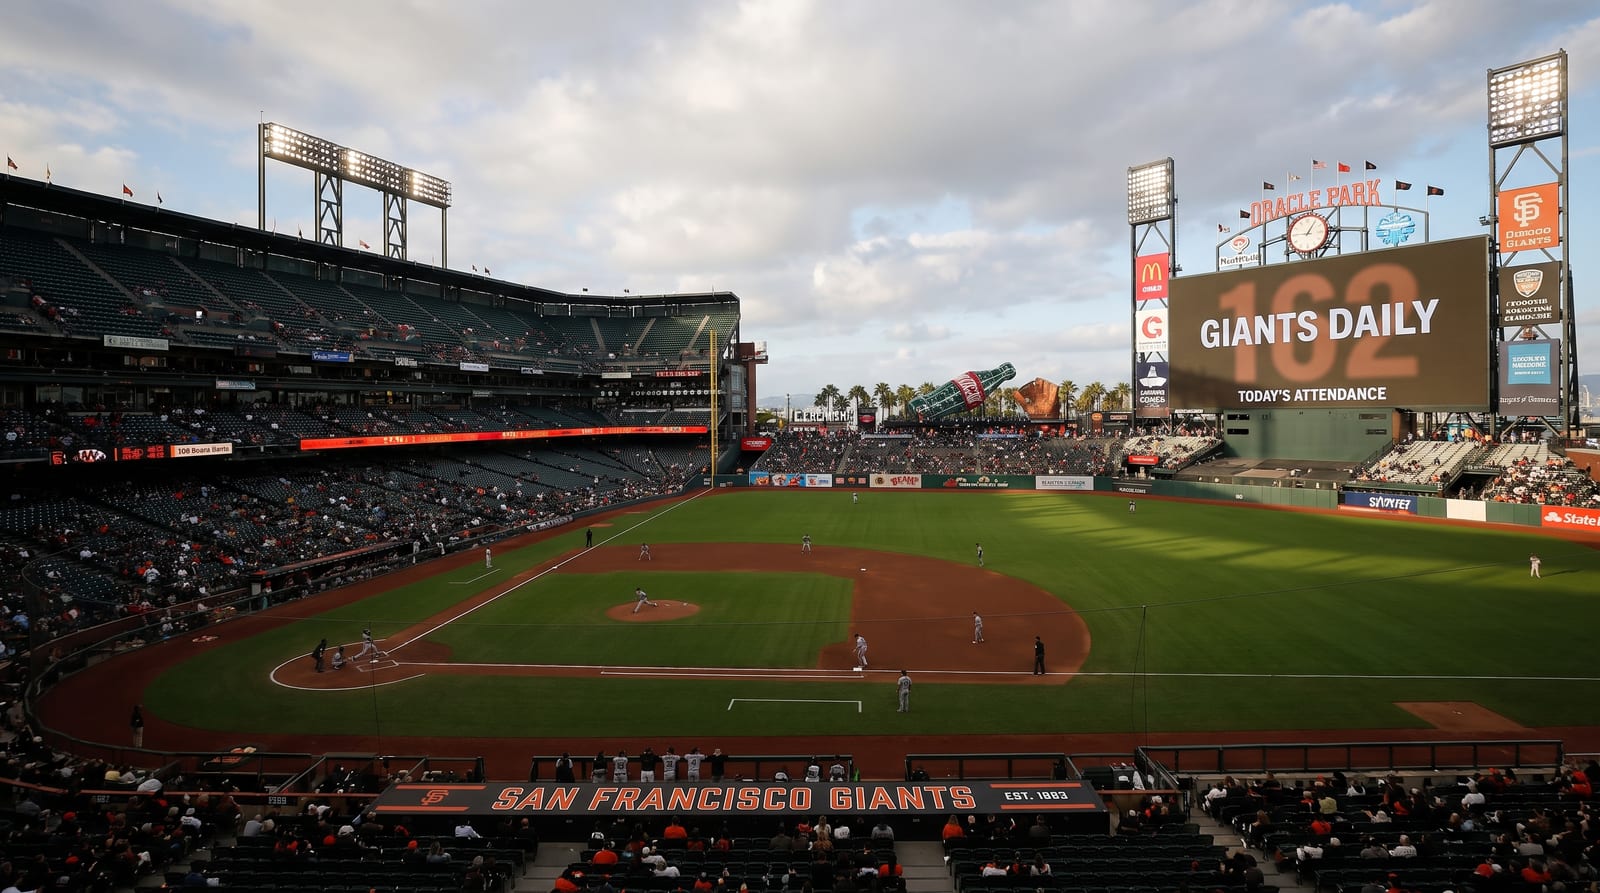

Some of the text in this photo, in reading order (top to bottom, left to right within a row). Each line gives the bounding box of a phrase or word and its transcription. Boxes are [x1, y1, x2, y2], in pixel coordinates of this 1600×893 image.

[1250, 178, 1381, 228] ORACLE PARK
[1506, 236, 1552, 248] GIANTS
[1200, 298, 1440, 349] GIANTS DAILY
[1219, 262, 1419, 384] 162
[1238, 387, 1387, 403] TODAY'S ATTENDANCE
[1563, 512, 1597, 526] State
[491, 785, 977, 811] SAN FRANCISCO GIANTS
[1004, 791, 1034, 800] EST.
